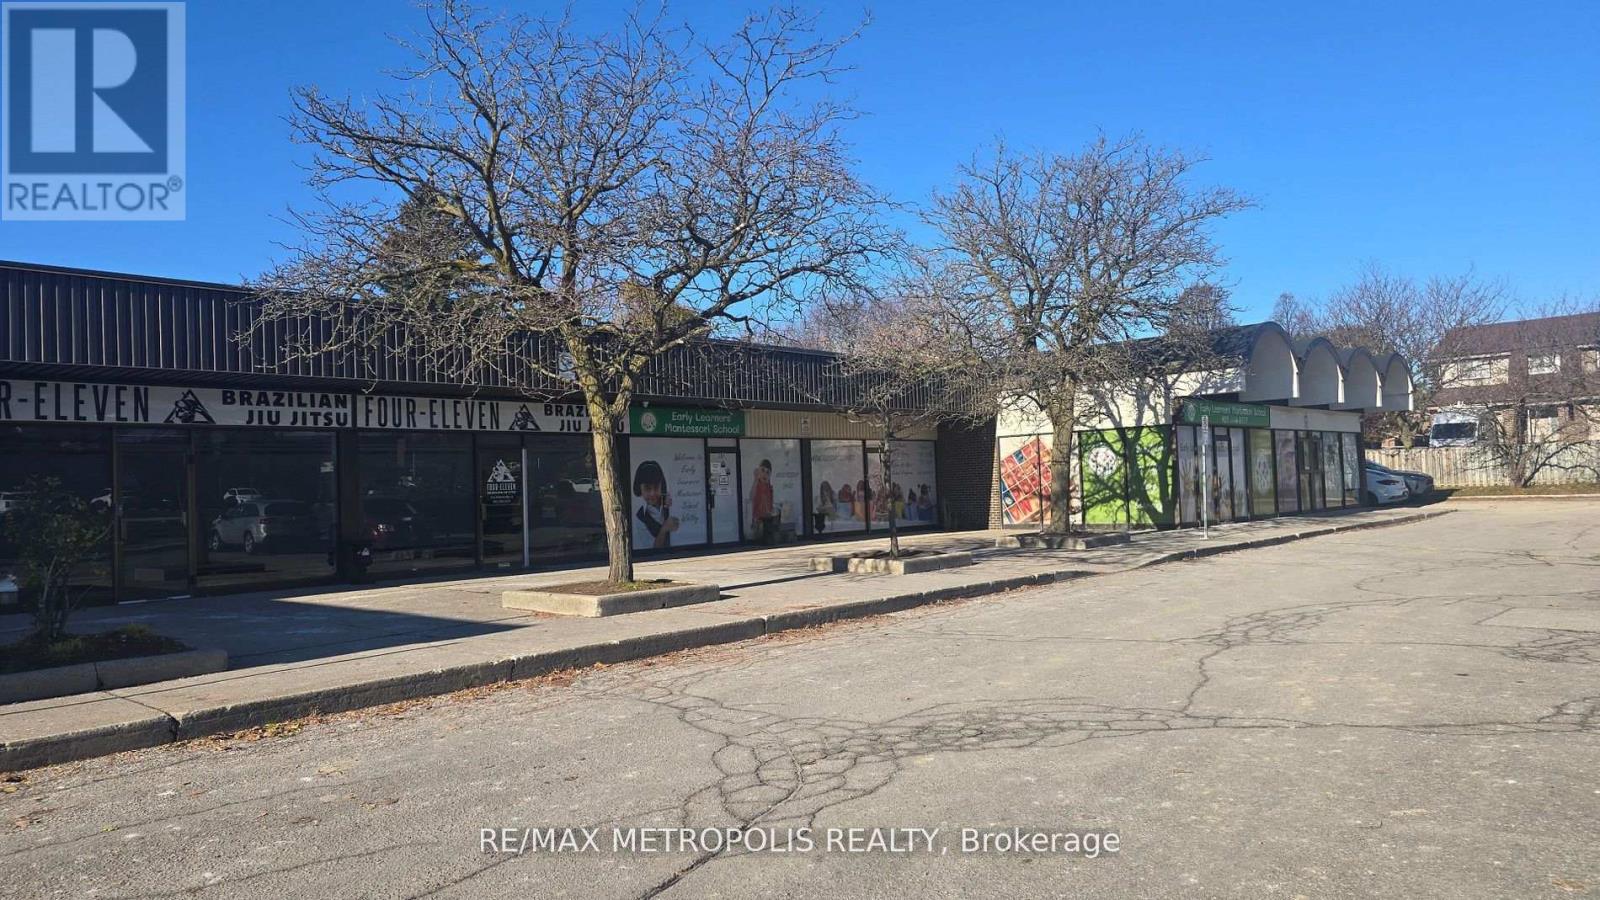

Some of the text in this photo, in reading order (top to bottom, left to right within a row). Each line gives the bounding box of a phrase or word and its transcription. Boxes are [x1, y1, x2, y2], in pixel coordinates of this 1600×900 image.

[222, 390, 347, 408] BRAZILIAN
[246, 410, 347, 426] JIU JITSU
[365, 397, 499, 429] FOUR-ELEVEN
[672, 411, 731, 424] Early Learners
[560, 419, 581, 431] JIU
[665, 423, 740, 434] Montessori School
